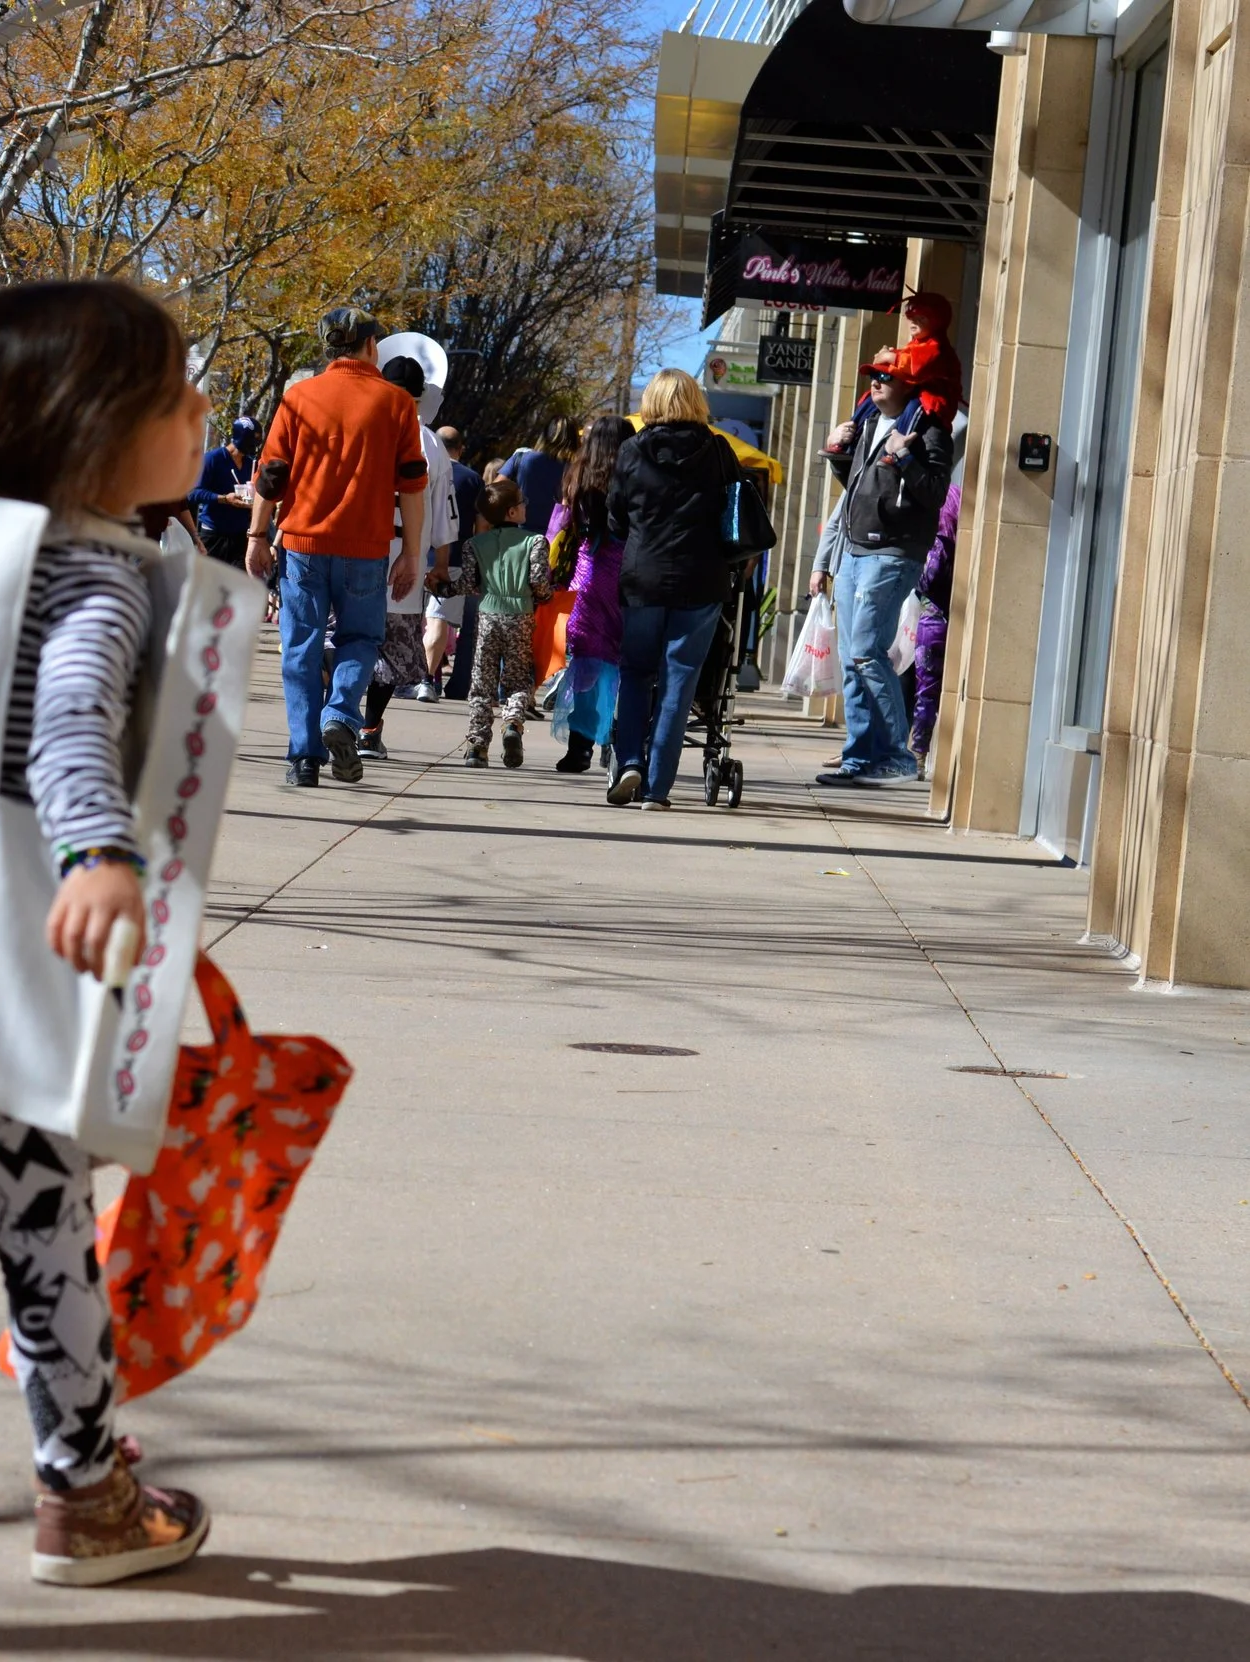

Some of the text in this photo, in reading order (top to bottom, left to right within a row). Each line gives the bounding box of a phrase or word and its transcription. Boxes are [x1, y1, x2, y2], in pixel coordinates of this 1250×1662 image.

[743, 254, 796, 283] Pink
[805, 258, 851, 287] White
[852, 266, 900, 292] Nails
[767, 342, 816, 358] YANKE
[765, 354, 815, 370] CANDL
[447, 494, 458, 520] 1
